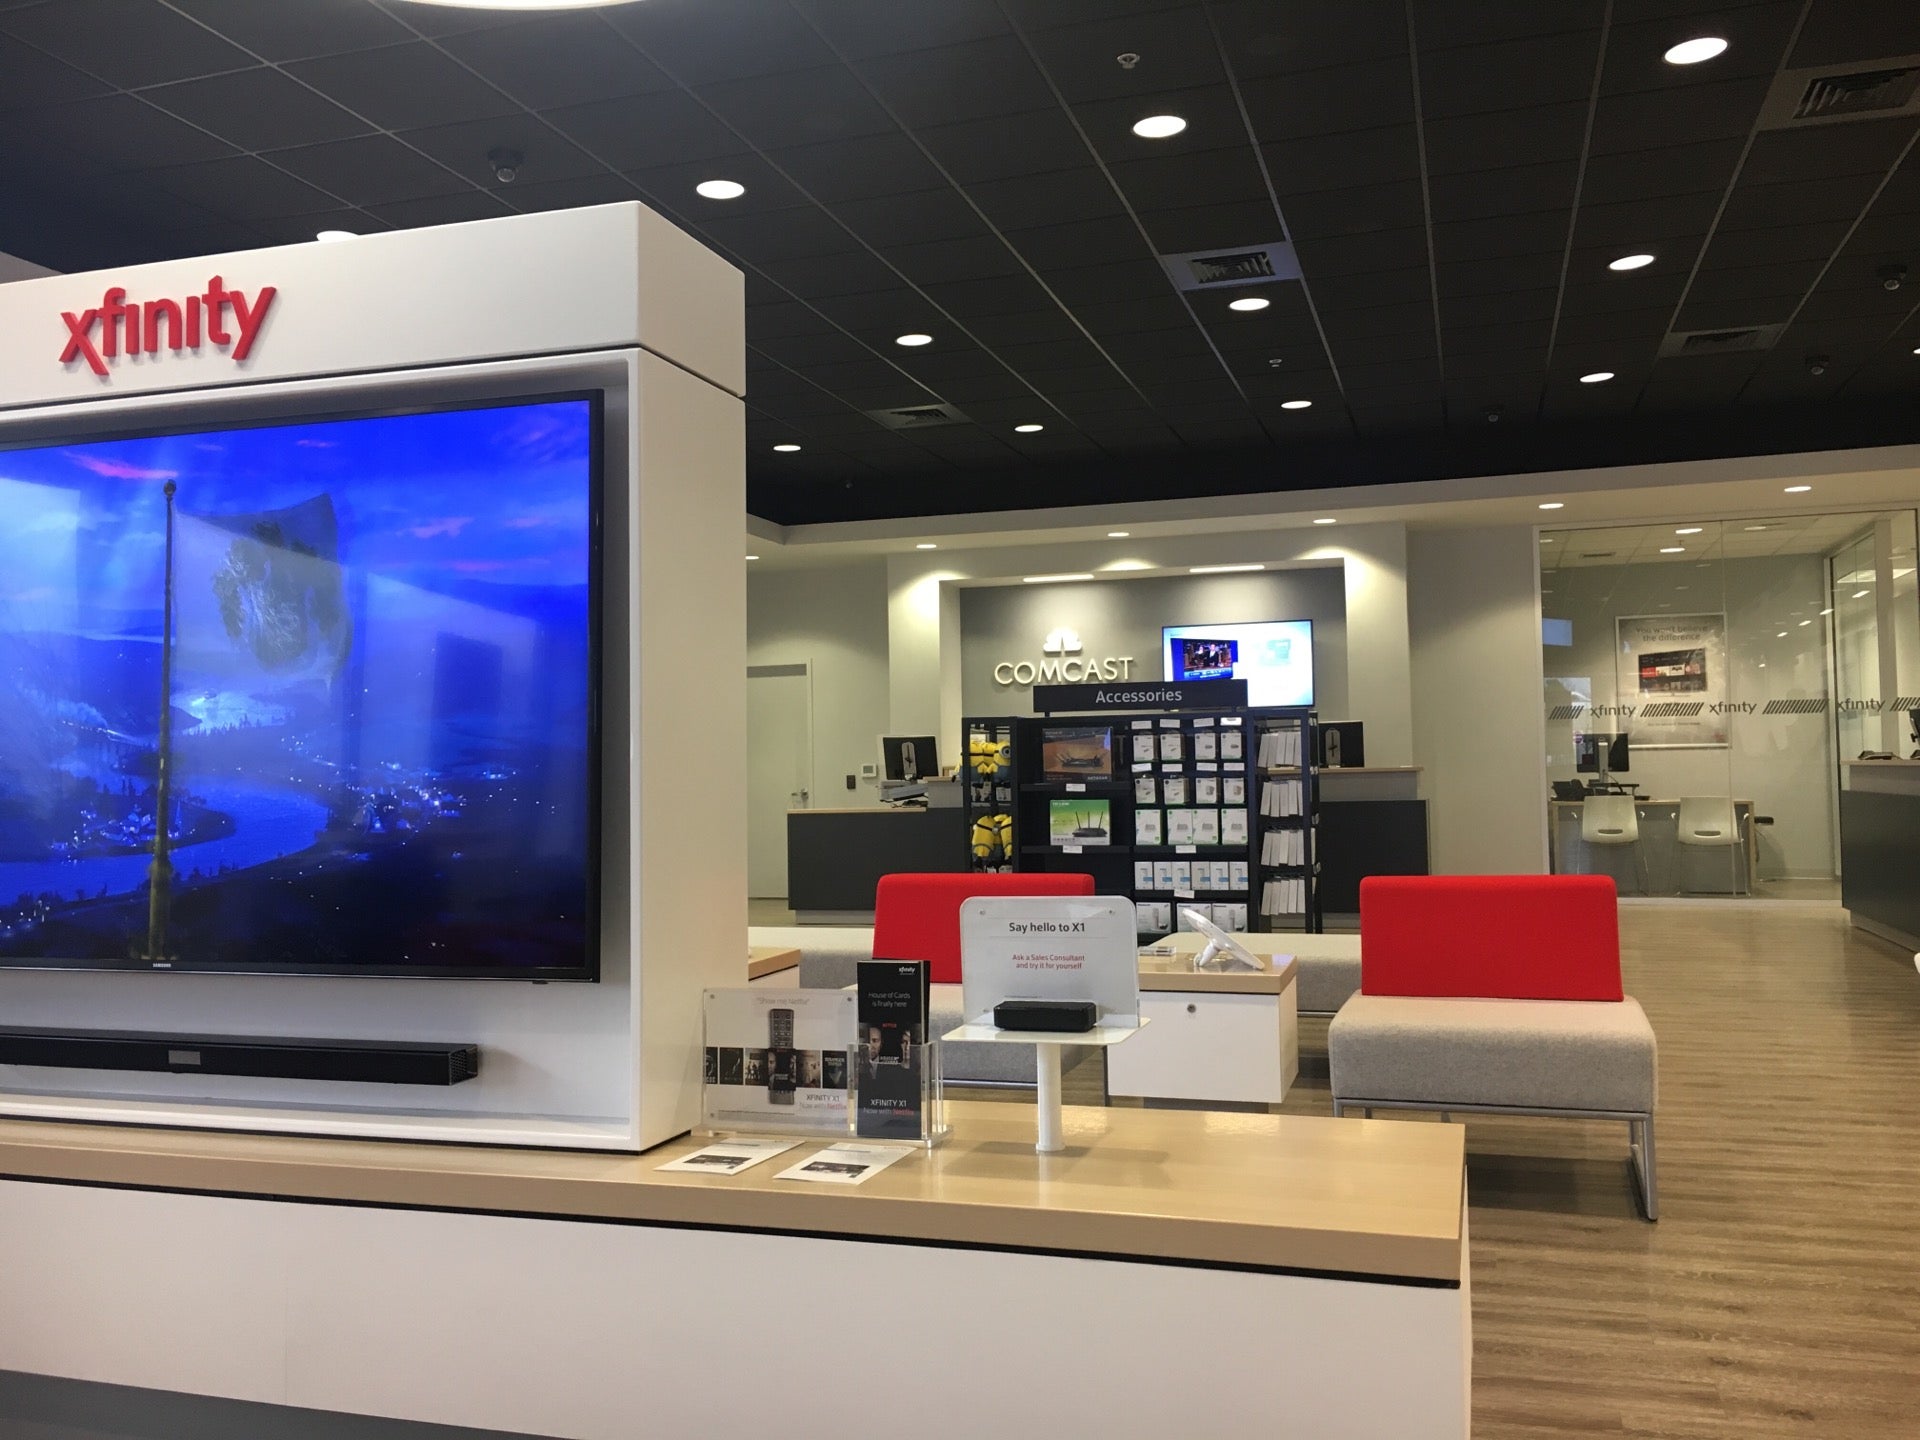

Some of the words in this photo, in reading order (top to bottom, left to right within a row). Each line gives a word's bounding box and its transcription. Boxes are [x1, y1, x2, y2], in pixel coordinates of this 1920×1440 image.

[59, 275, 277, 376] xfinity
[994, 656, 1134, 685] COMCAST
[1095, 688, 1182, 704] Accessories
[1590, 704, 1636, 718] xfinity
[1709, 701, 1757, 715] xfinity
[1836, 698, 1885, 712] xfinity
[1009, 922, 1028, 934] Say
[1030, 922, 1056, 932] hello
[1058, 923, 1070, 932] to
[1072, 923, 1085, 932] X1
[1029, 962, 1038, 970] try
[1056, 962, 1082, 970] yourself
